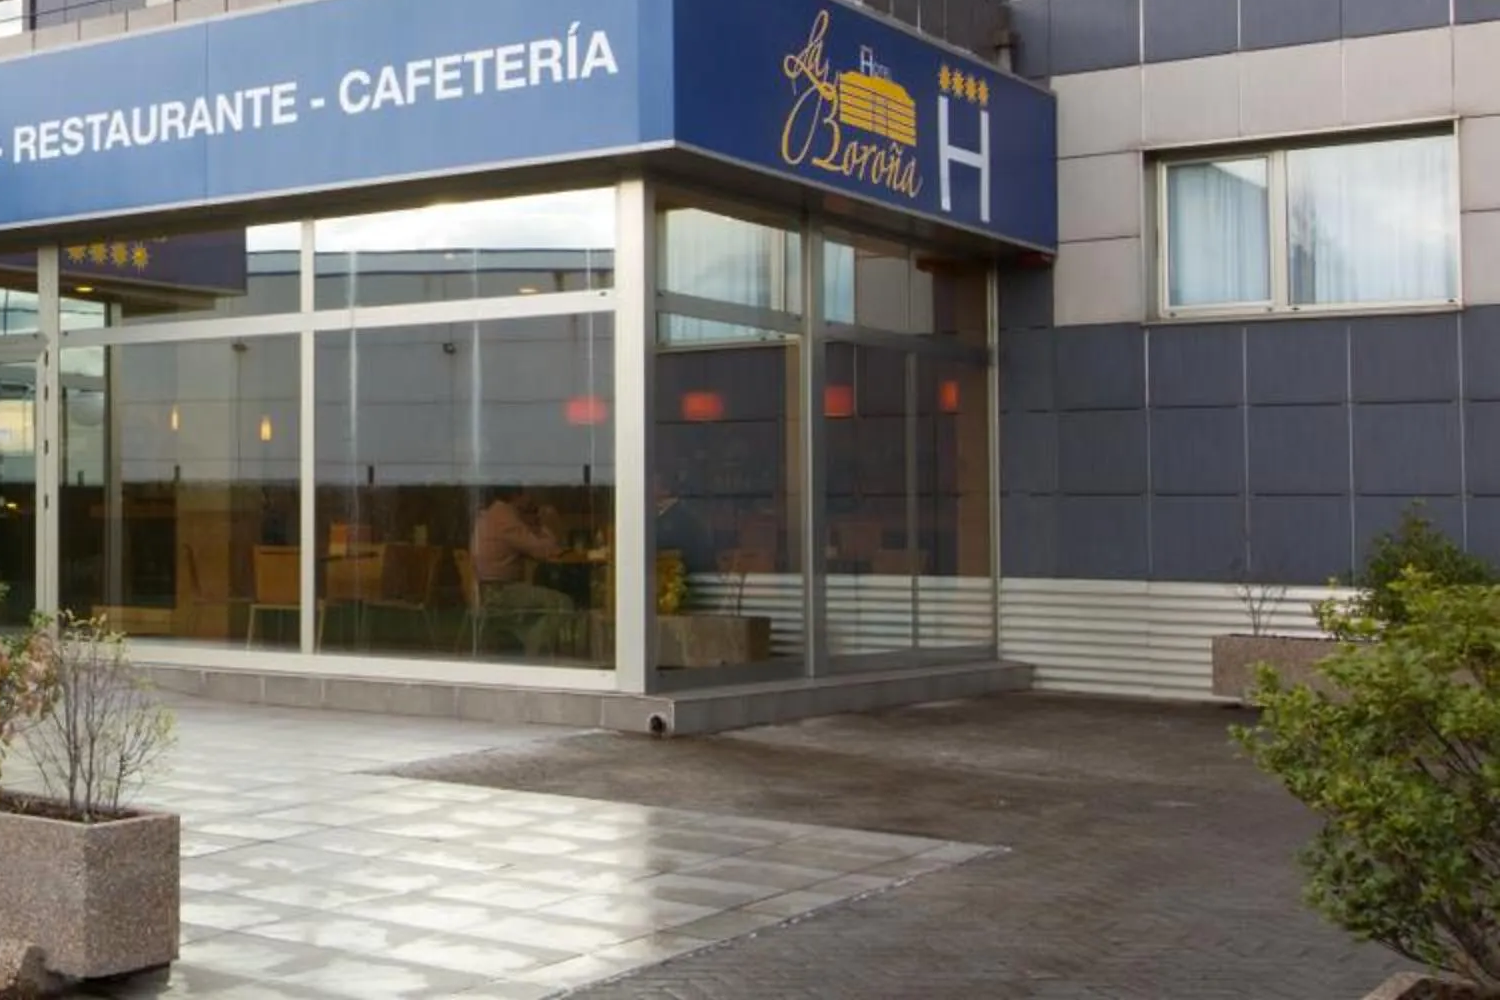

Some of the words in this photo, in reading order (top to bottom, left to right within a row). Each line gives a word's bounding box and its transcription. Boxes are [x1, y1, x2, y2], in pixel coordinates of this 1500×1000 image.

[13, 81, 299, 164] RESTAURANTE
[339, 22, 619, 115] CAFETERÍA
[938, 95, 991, 223] H
